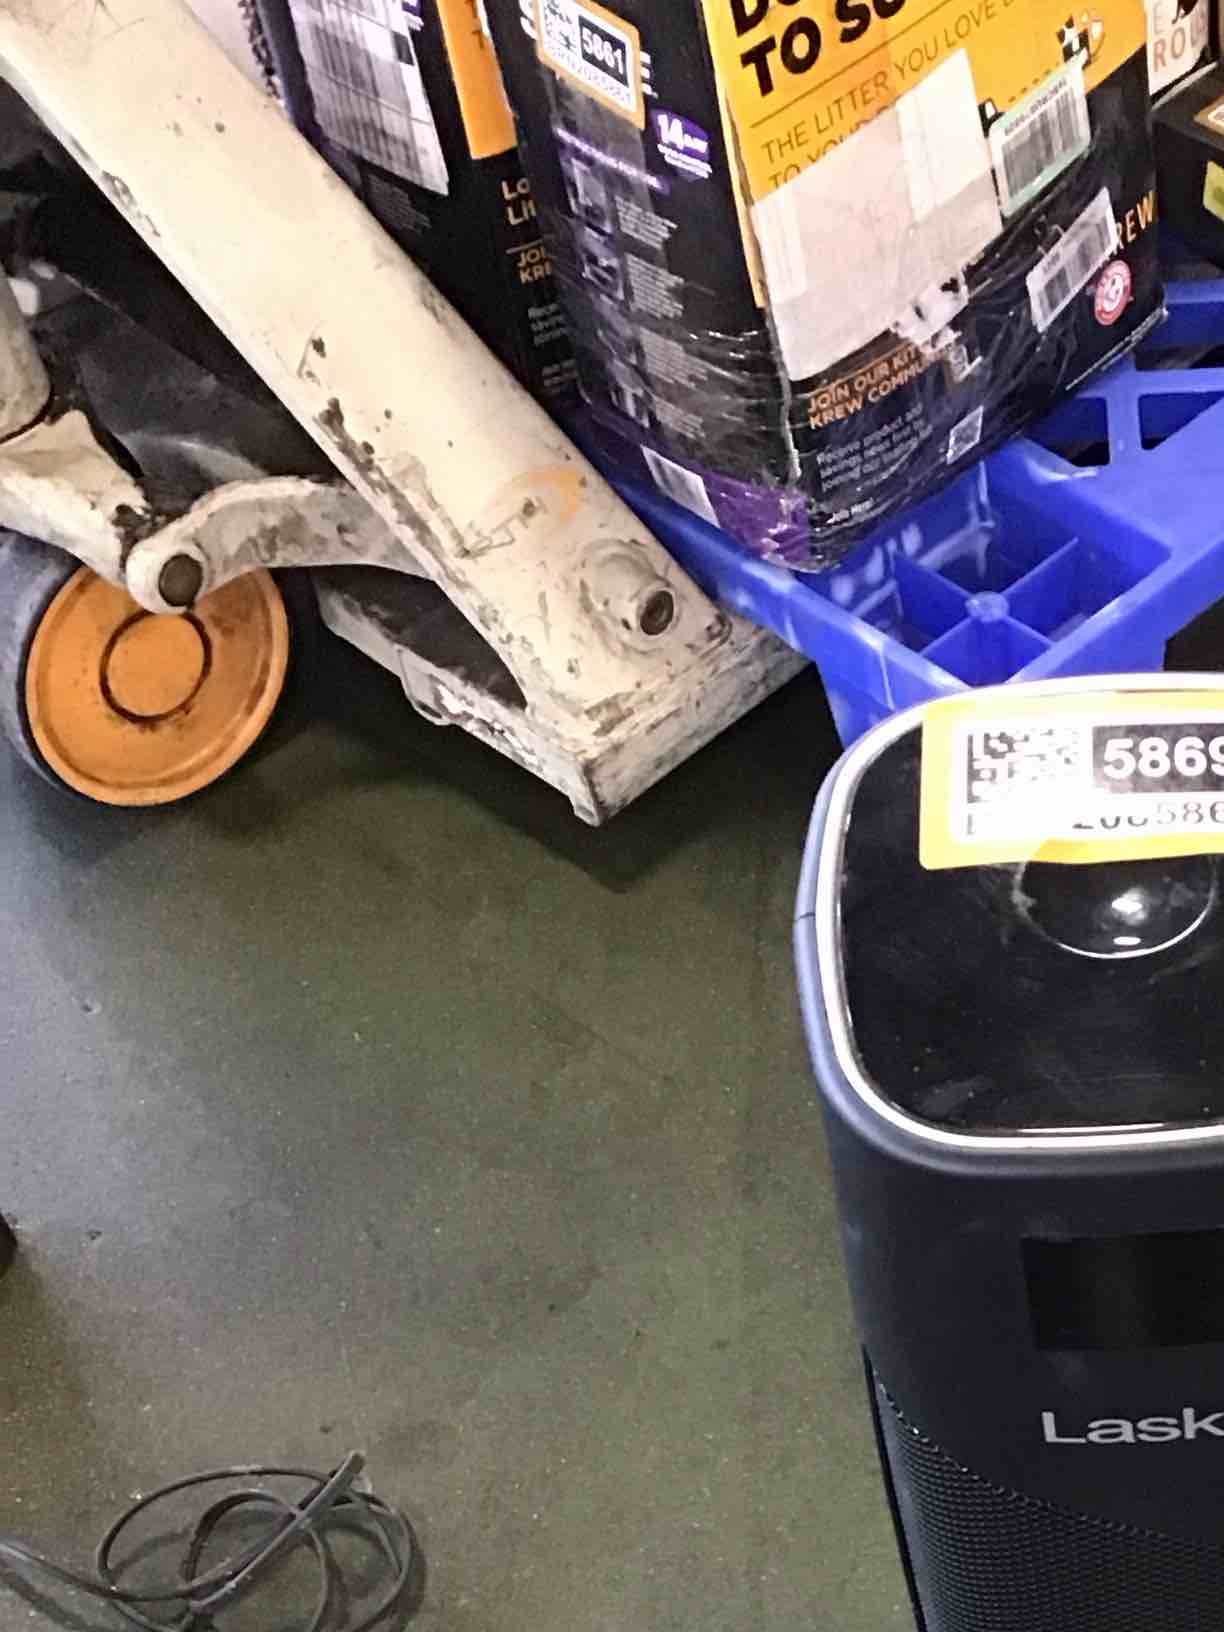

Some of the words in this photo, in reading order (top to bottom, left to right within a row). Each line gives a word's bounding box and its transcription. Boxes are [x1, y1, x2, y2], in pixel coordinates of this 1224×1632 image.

[741, 16, 821, 97] TO
[761, 122, 806, 164] THE
[813, 71, 889, 134] LITTER
[894, 35, 940, 78] YOU
[943, 2, 998, 49] LOVE
[808, 384, 850, 414] JOIN
[854, 361, 890, 392] OUR
[808, 394, 863, 430] KREW
